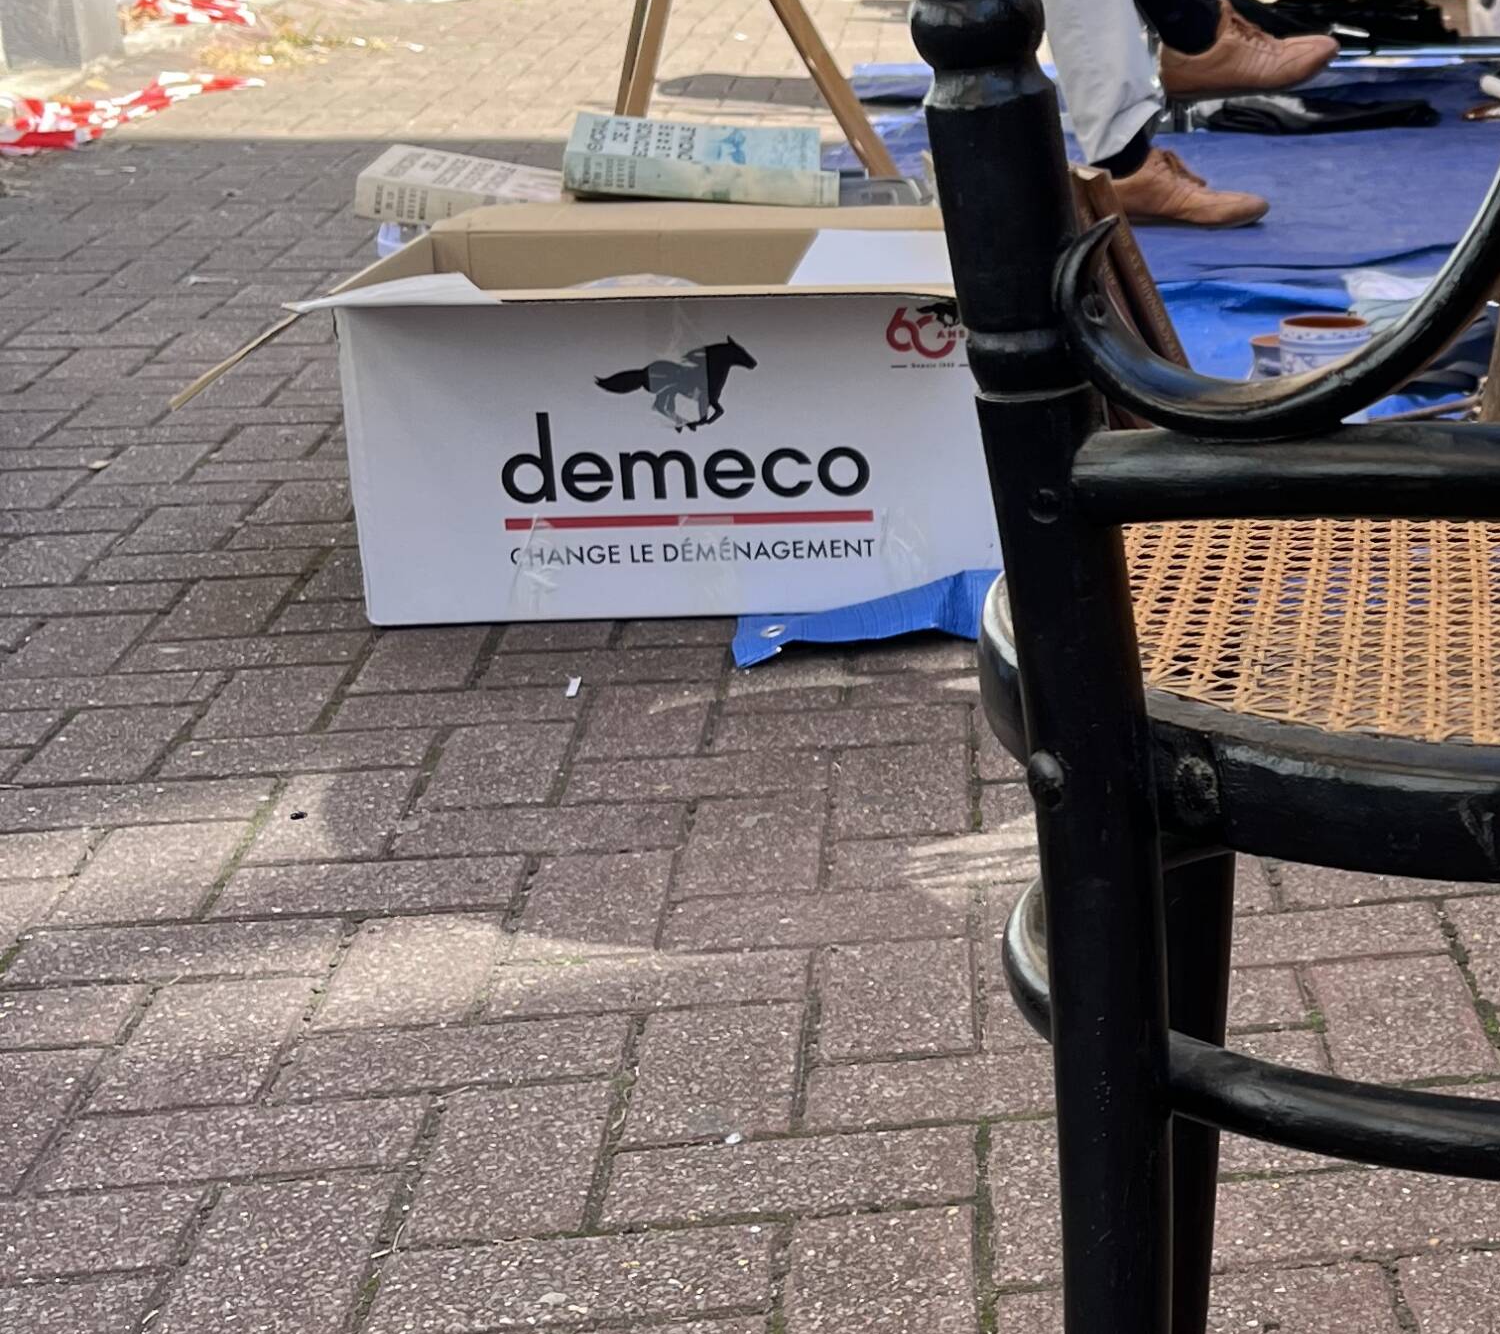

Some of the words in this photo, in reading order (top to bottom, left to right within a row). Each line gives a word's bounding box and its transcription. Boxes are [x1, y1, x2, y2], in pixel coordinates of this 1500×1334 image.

[501, 412, 871, 504] demeco
[630, 543, 655, 564] LE
[663, 537, 875, 563] DÉMÉNAGEMENT
